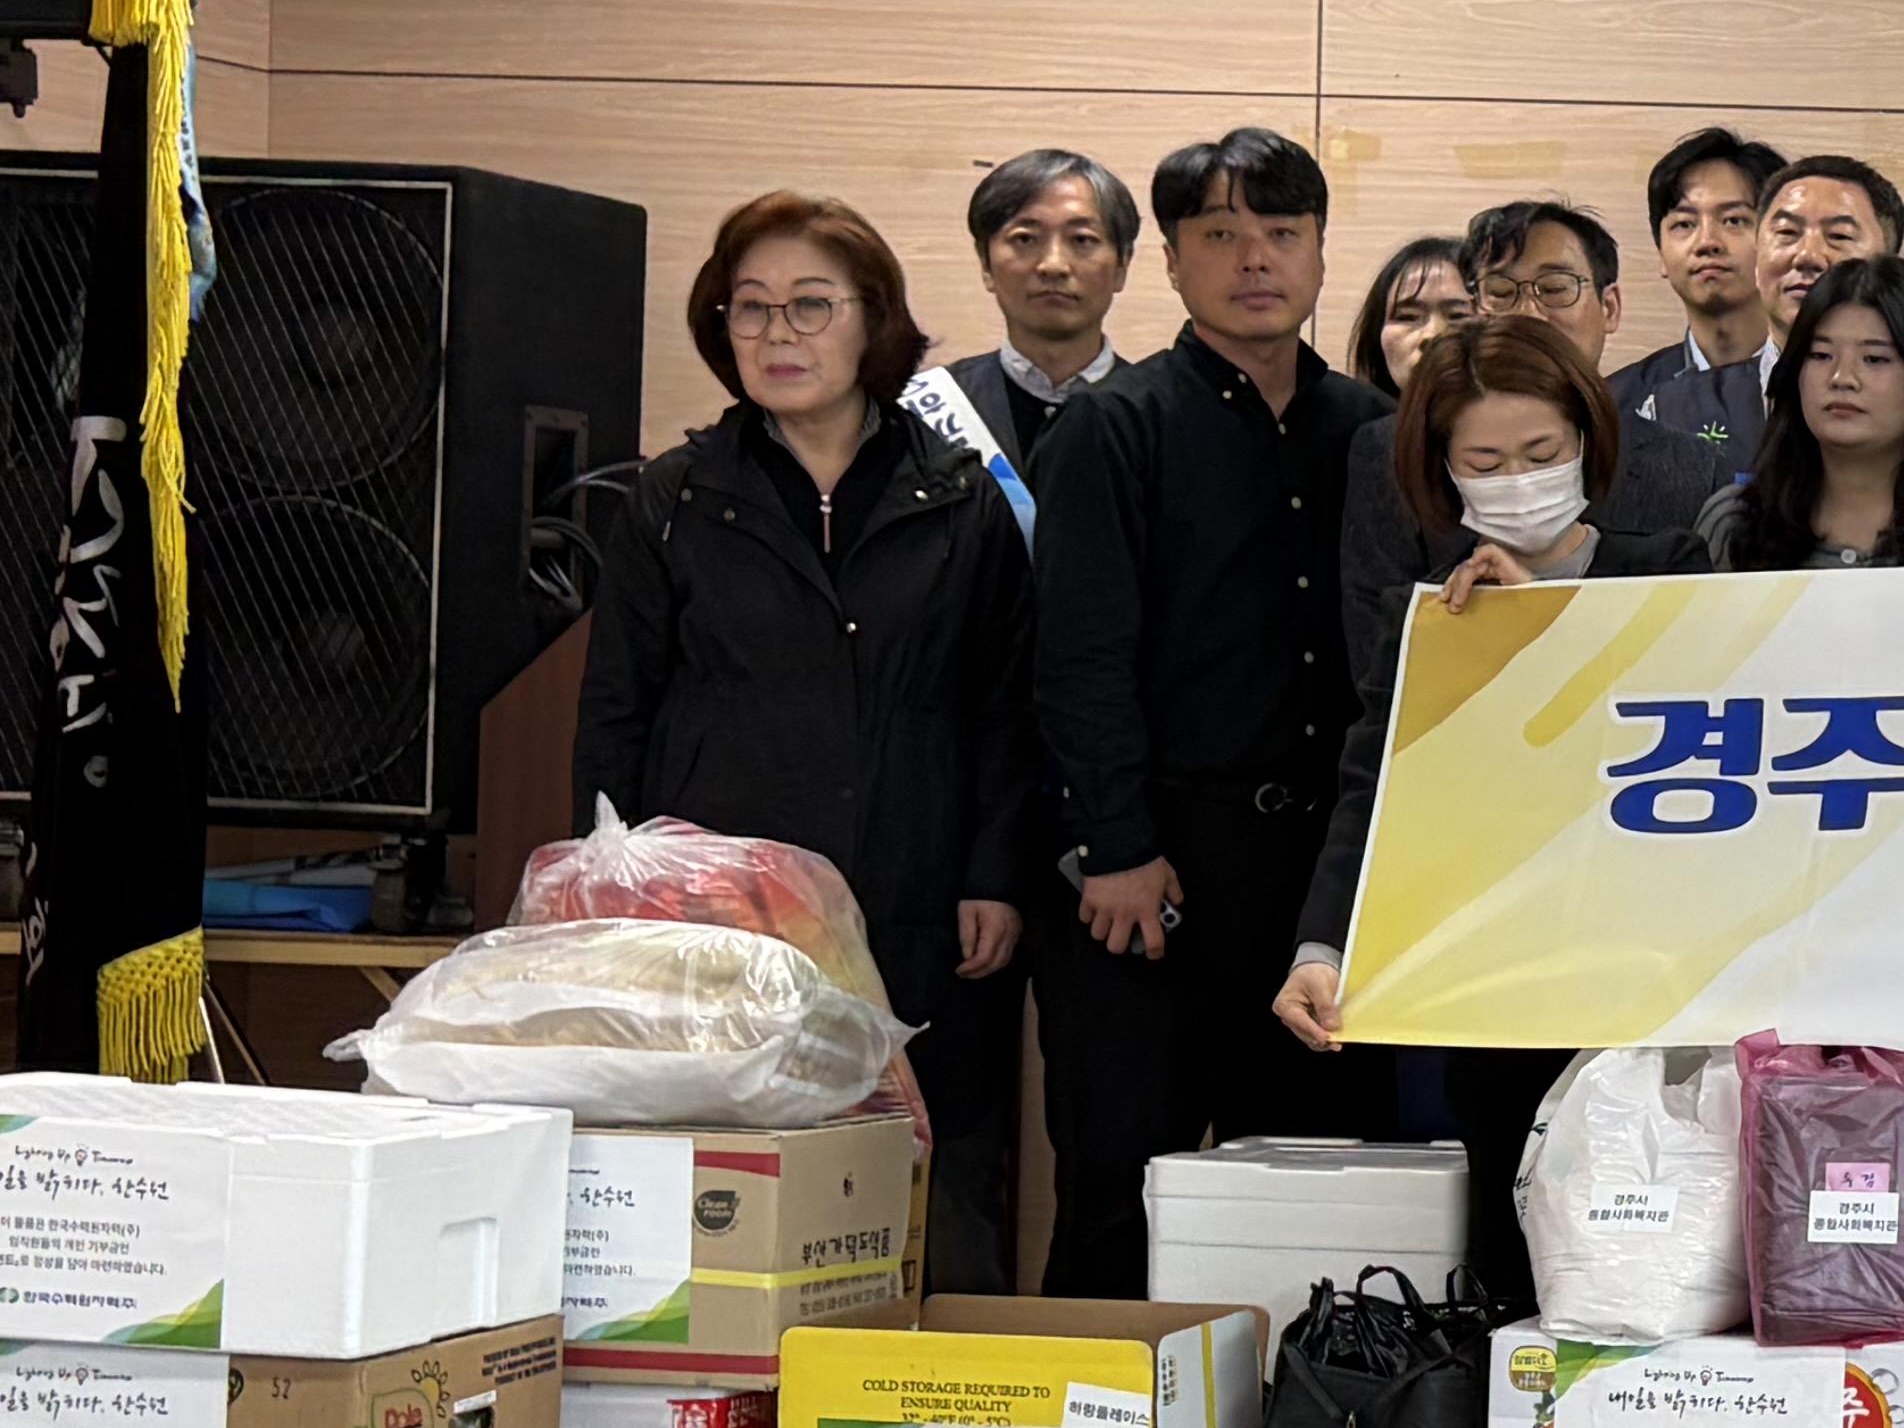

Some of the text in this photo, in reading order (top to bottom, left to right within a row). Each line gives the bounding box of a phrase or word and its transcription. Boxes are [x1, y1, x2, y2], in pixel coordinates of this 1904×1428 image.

[1838, 1201, 1876, 1216] 경주시
[862, 1380, 1051, 1400] COLD STORAGE REQUIRED TO
[899, 1397, 1012, 1414] ENSURE QUALITY
